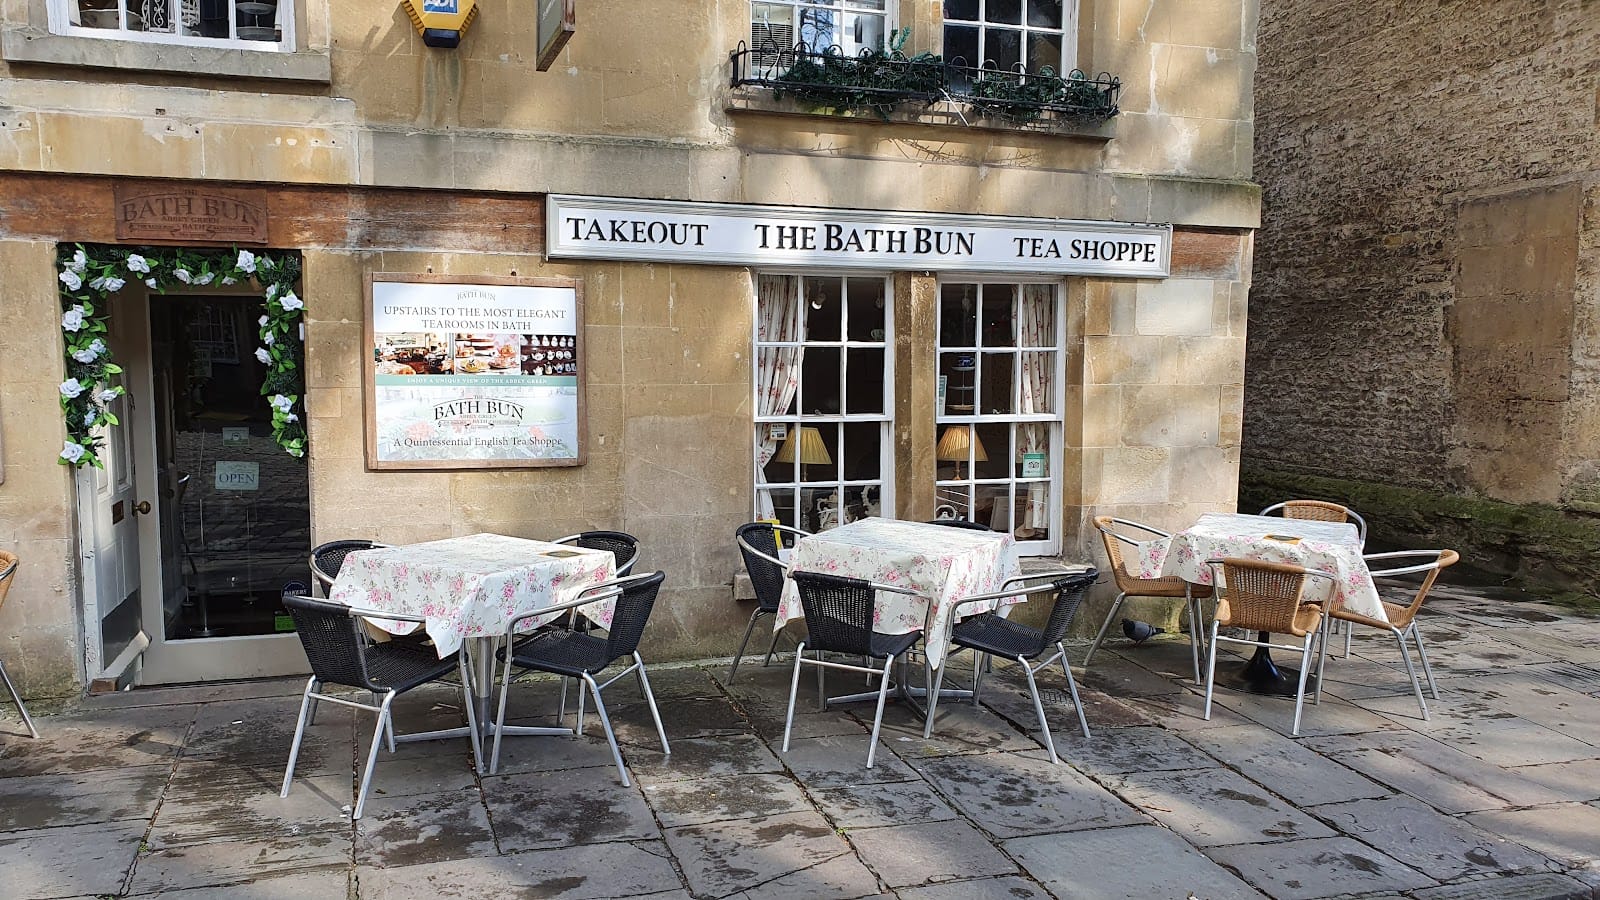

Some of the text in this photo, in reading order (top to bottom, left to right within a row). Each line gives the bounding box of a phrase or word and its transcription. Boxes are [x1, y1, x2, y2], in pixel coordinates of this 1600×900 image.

[122, 197, 261, 227] BATH BUN
[566, 217, 709, 246] TAKEOUT
[754, 223, 817, 250] THE
[1013, 236, 1062, 259] TEA
[1070, 239, 1156, 263] SHOPPE
[384, 305, 567, 319] UPSTAIRS TO THE MOST ELEGANT
[421, 319, 531, 331] TEAROOMS IN BATH
[434, 400, 524, 420] BATH BUN
[393, 436, 562, 450] A Quintessential English Tea Shoppe
[219, 473, 255, 484] OPEN
